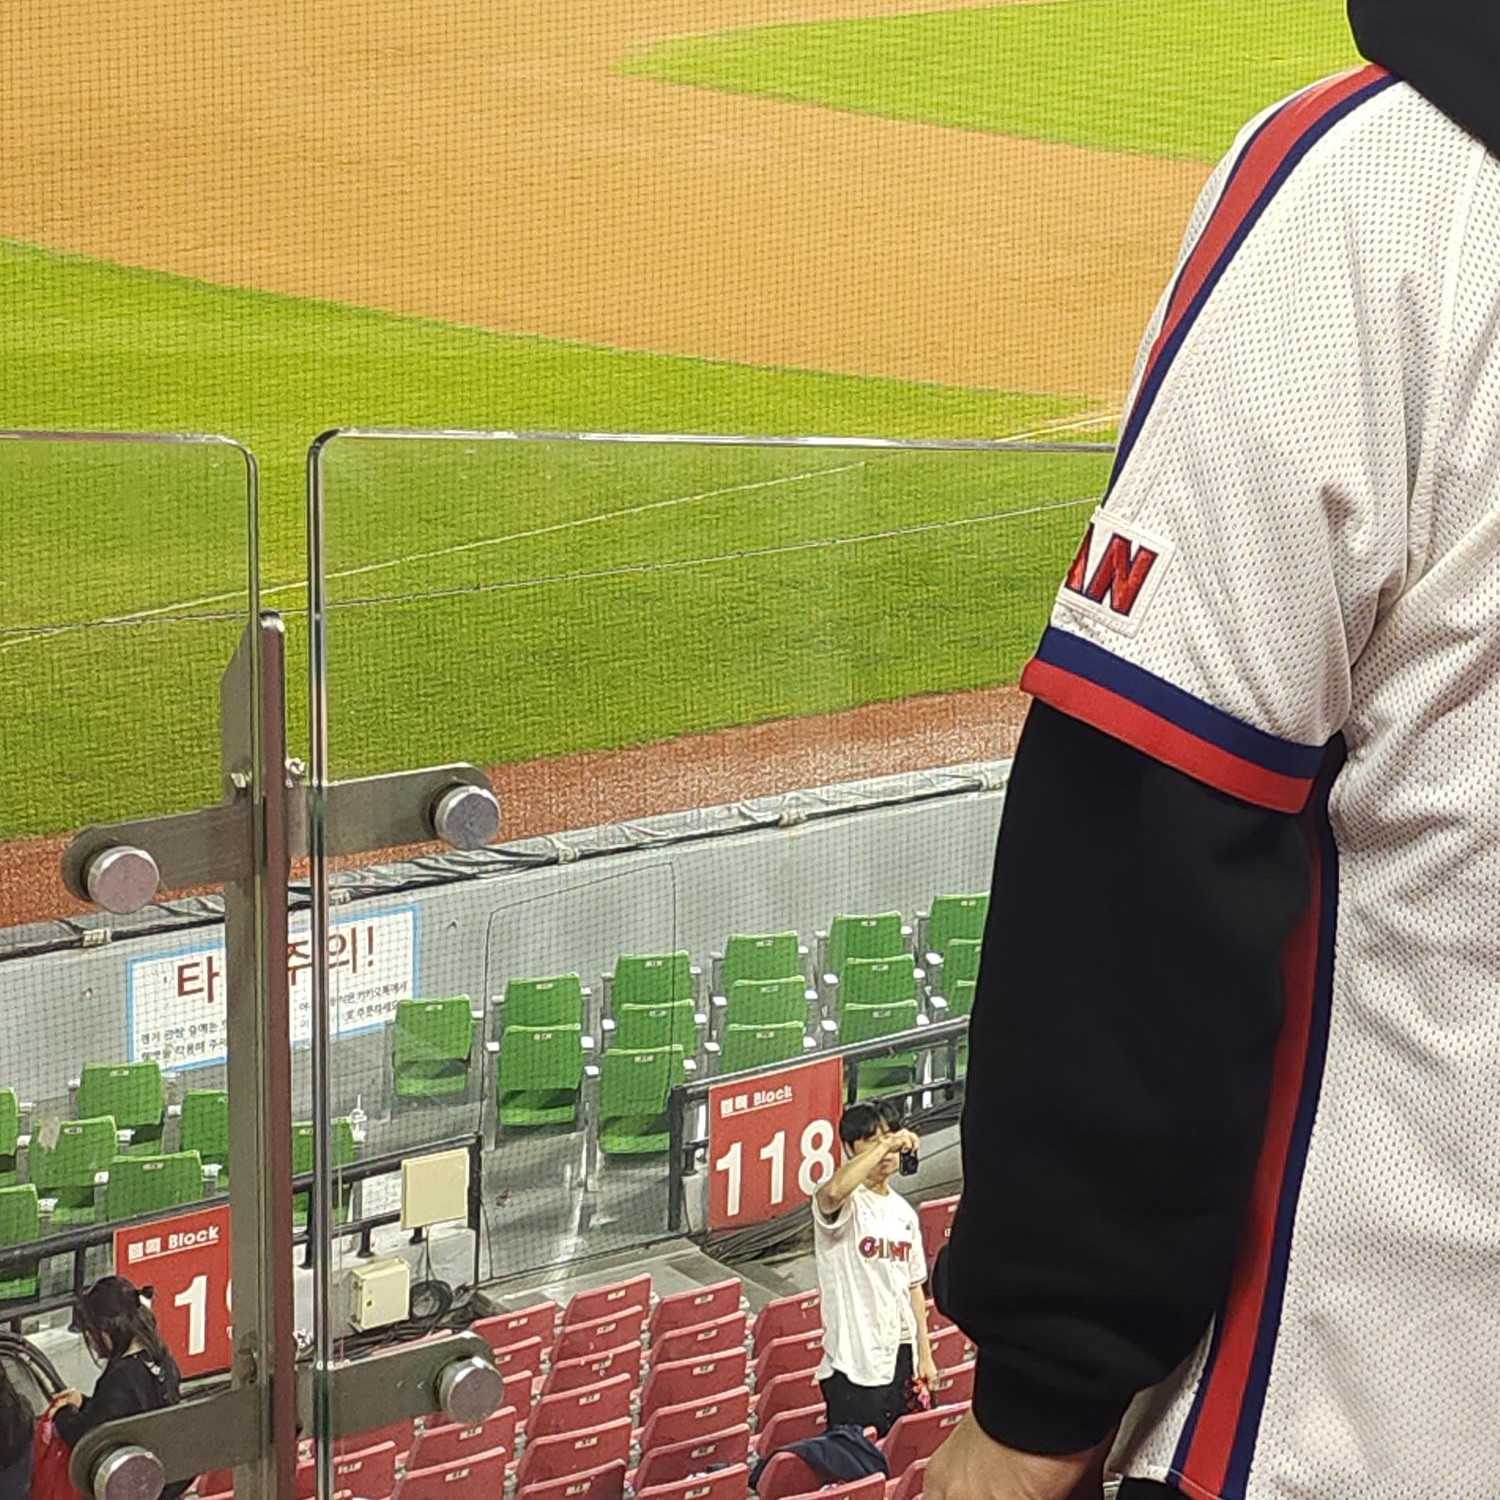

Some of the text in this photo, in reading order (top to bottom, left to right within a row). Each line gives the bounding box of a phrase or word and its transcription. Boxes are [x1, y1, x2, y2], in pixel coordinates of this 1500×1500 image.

[754, 1084, 793, 1106] Block
[716, 1119, 834, 1217] 118
[168, 1225, 219, 1249] Block
